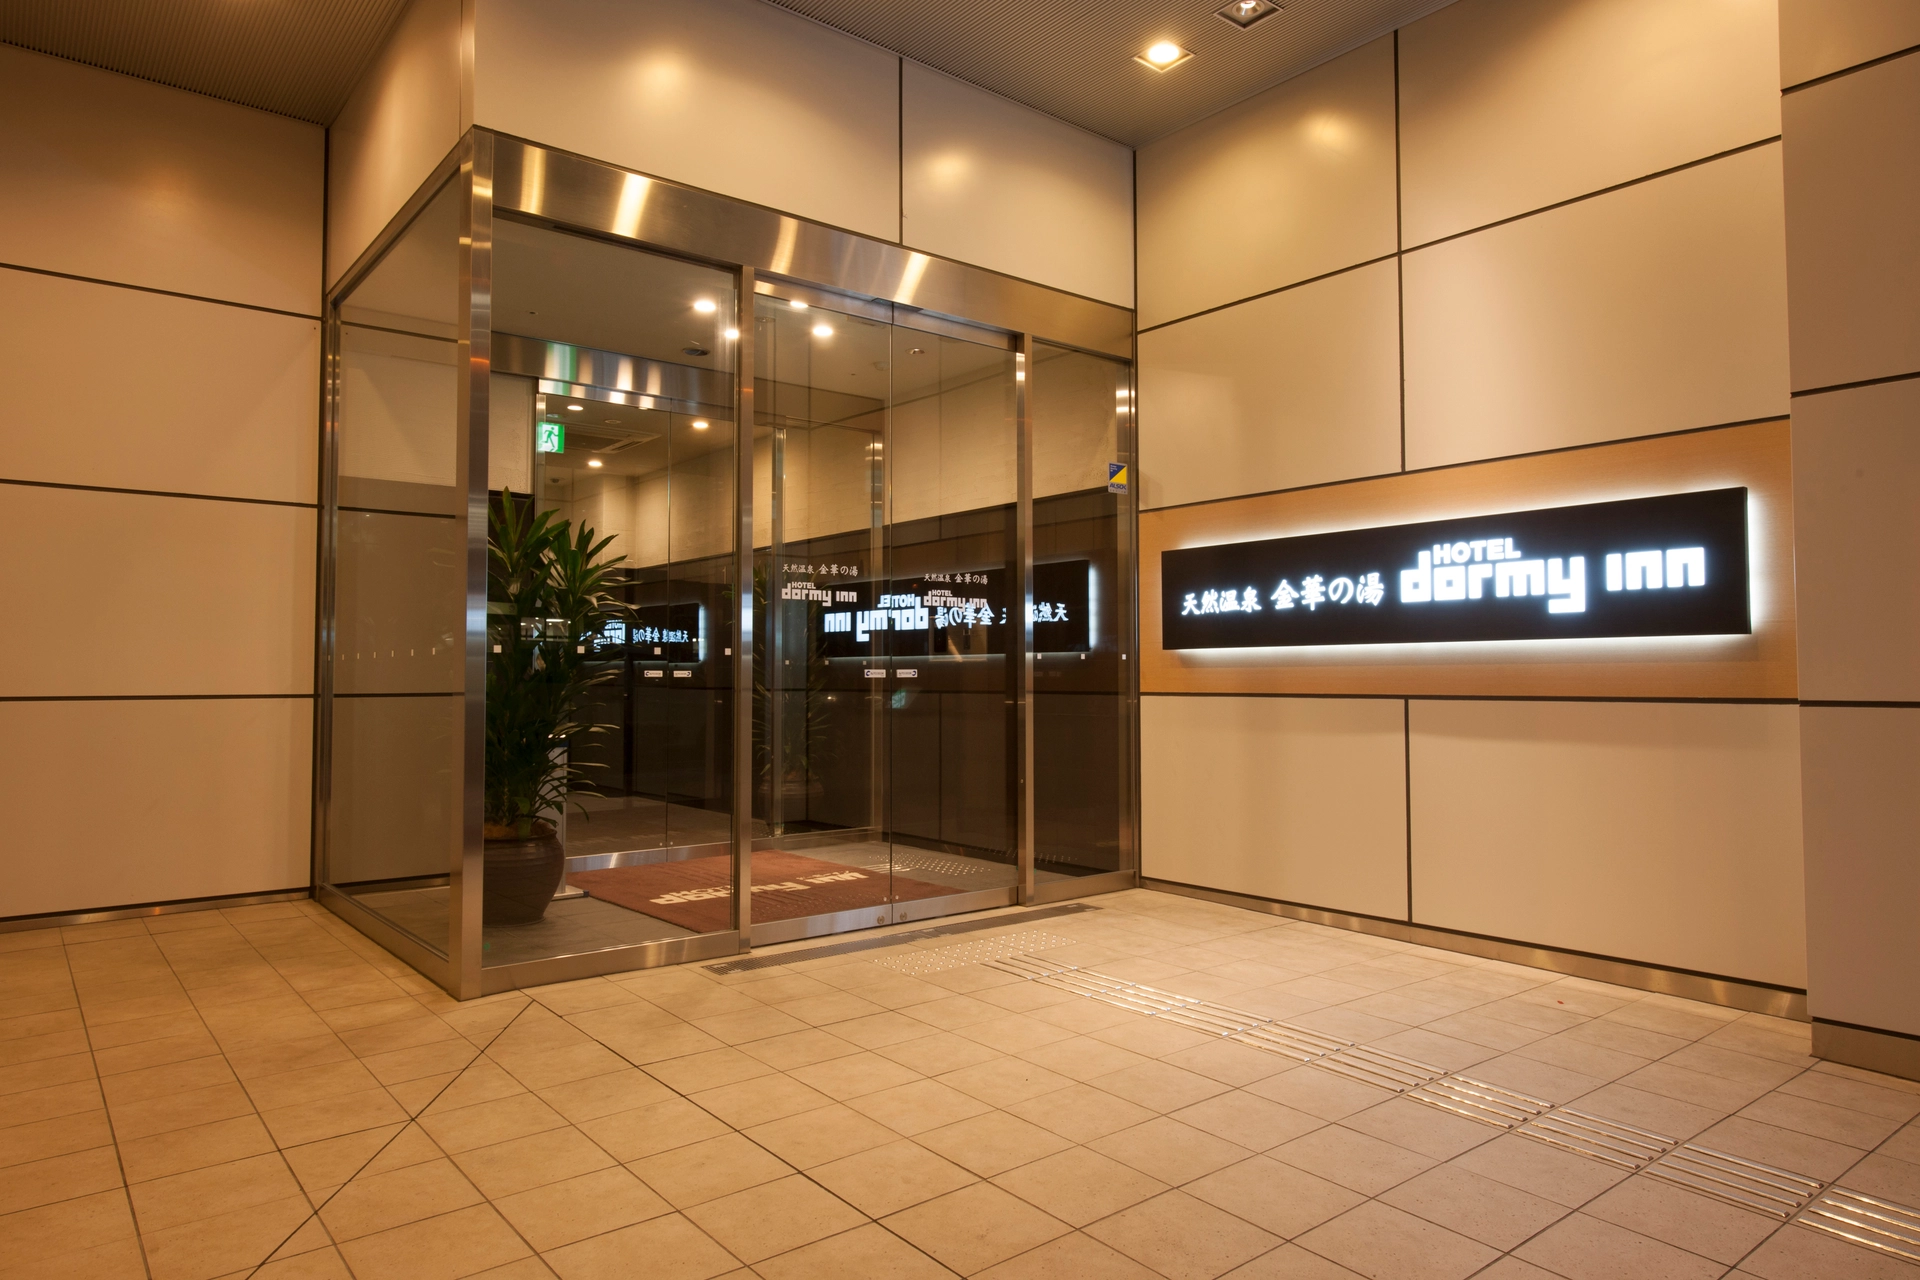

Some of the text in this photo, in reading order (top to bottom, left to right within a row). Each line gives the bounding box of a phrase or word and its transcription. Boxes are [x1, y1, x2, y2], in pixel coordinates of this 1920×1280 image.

[1433, 538, 1521, 565] HOTEL
[782, 563, 859, 577] 天然温泉 金華の湯
[923, 573, 951, 583] 天然温泉
[1400, 547, 1705, 614] dormy inn
[781, 582, 858, 607] dormy inn
[791, 581, 816, 590] HOTEL
[931, 589, 953, 597] HOTEL
[1181, 572, 1385, 616] 天然温泉 金華の湯
[923, 590, 966, 612] dormy
